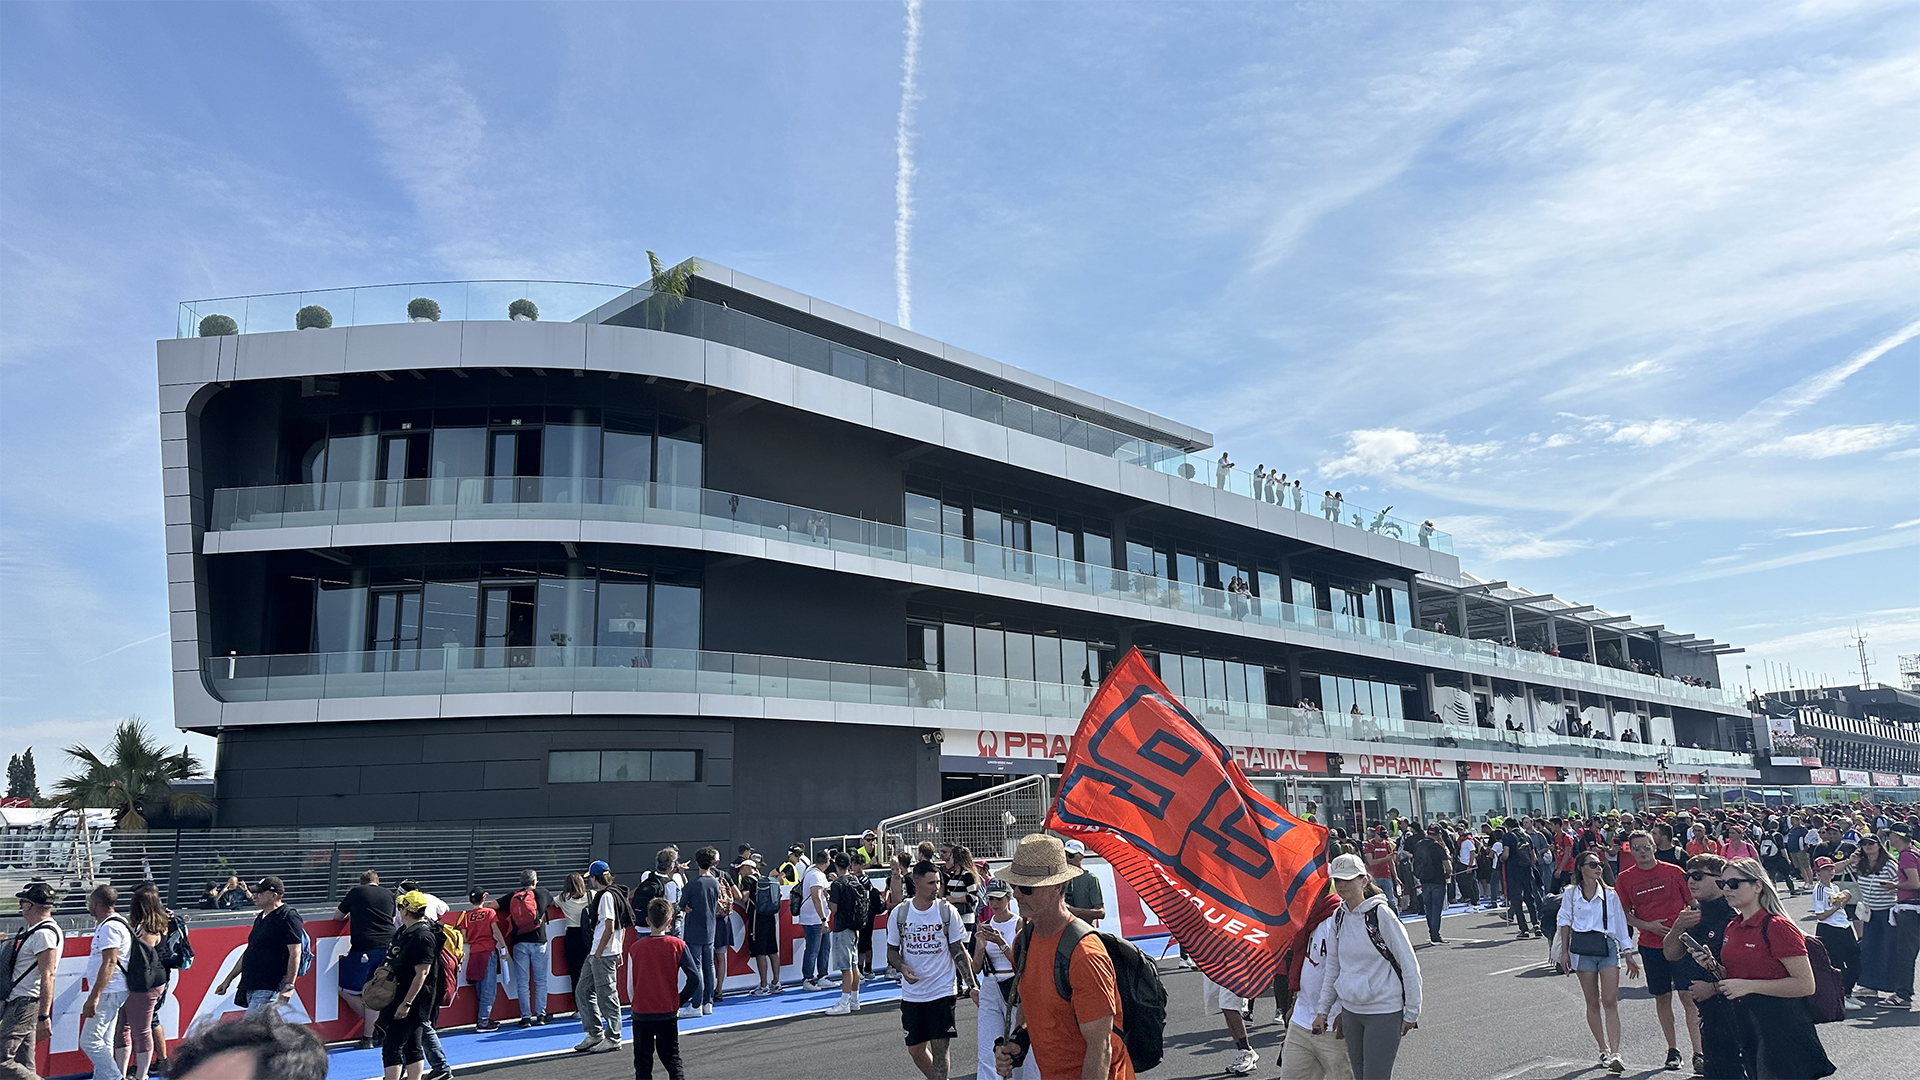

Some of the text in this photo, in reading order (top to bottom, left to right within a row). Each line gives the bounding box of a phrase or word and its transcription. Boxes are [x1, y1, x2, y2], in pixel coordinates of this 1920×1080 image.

[1004, 731, 1074, 758] PRA
[1373, 755, 1443, 776] PRAMAC
[1493, 763, 1546, 781] PRAMAC
[1583, 768, 1627, 783] PRAMAC
